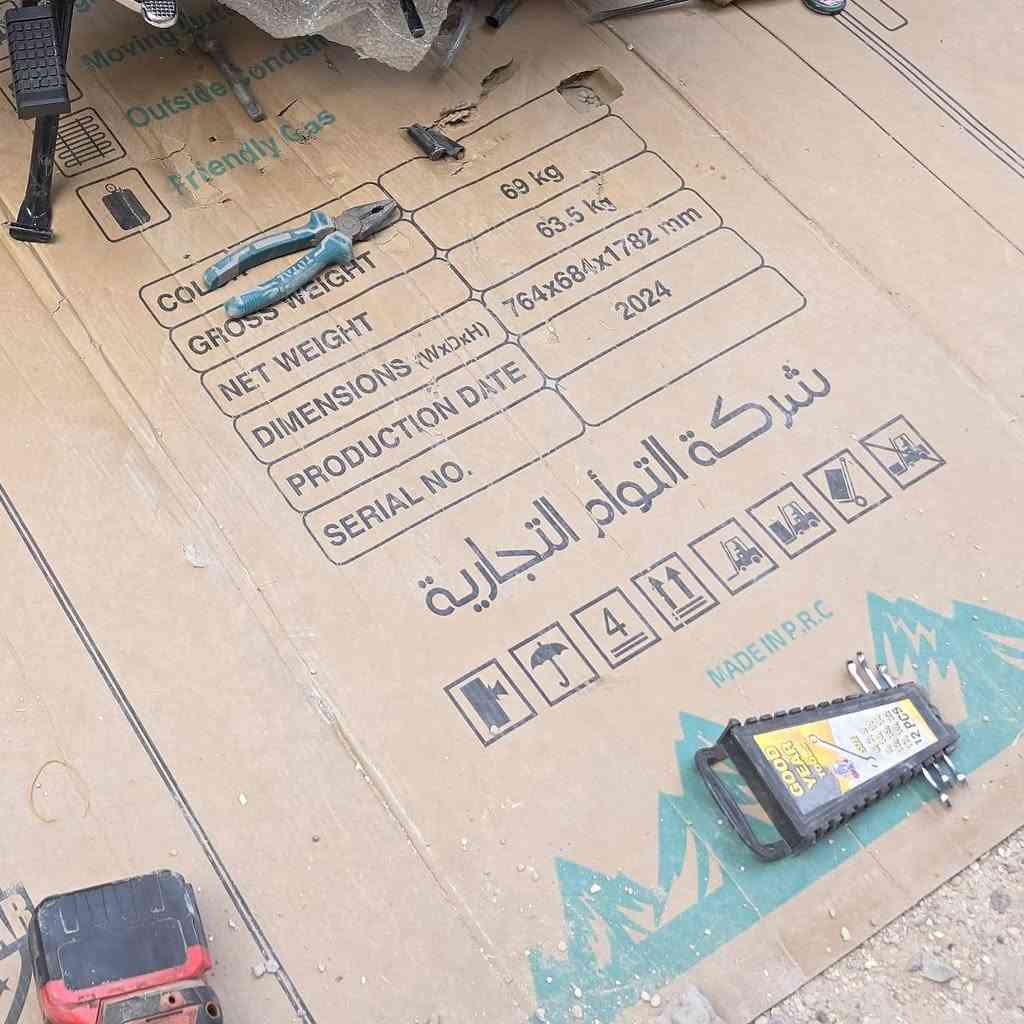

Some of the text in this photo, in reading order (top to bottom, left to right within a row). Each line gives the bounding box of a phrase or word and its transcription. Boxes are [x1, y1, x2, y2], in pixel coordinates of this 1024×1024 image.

[127, 79, 226, 128] Outside
[167, 137, 281, 193] Friendly
[500, 164, 564, 200] 69 kg
[536, 196, 617, 239] 63.5 kg
[657, 207, 703, 236] mm
[615, 280, 672, 320] 2024
[218, 312, 374, 402] NET WEIGHT
[251, 358, 413, 449] DIMENSIONS
[287, 361, 527, 497] PRODUCTION DATE
[679, 363, 832, 467] شركة
[324, 459, 473, 546] SERIAL NO.
[418, 495, 580, 617] التجارية
[706, 599, 834, 689] MADE IN P.R.C
[765, 745, 804, 797] GOOD
